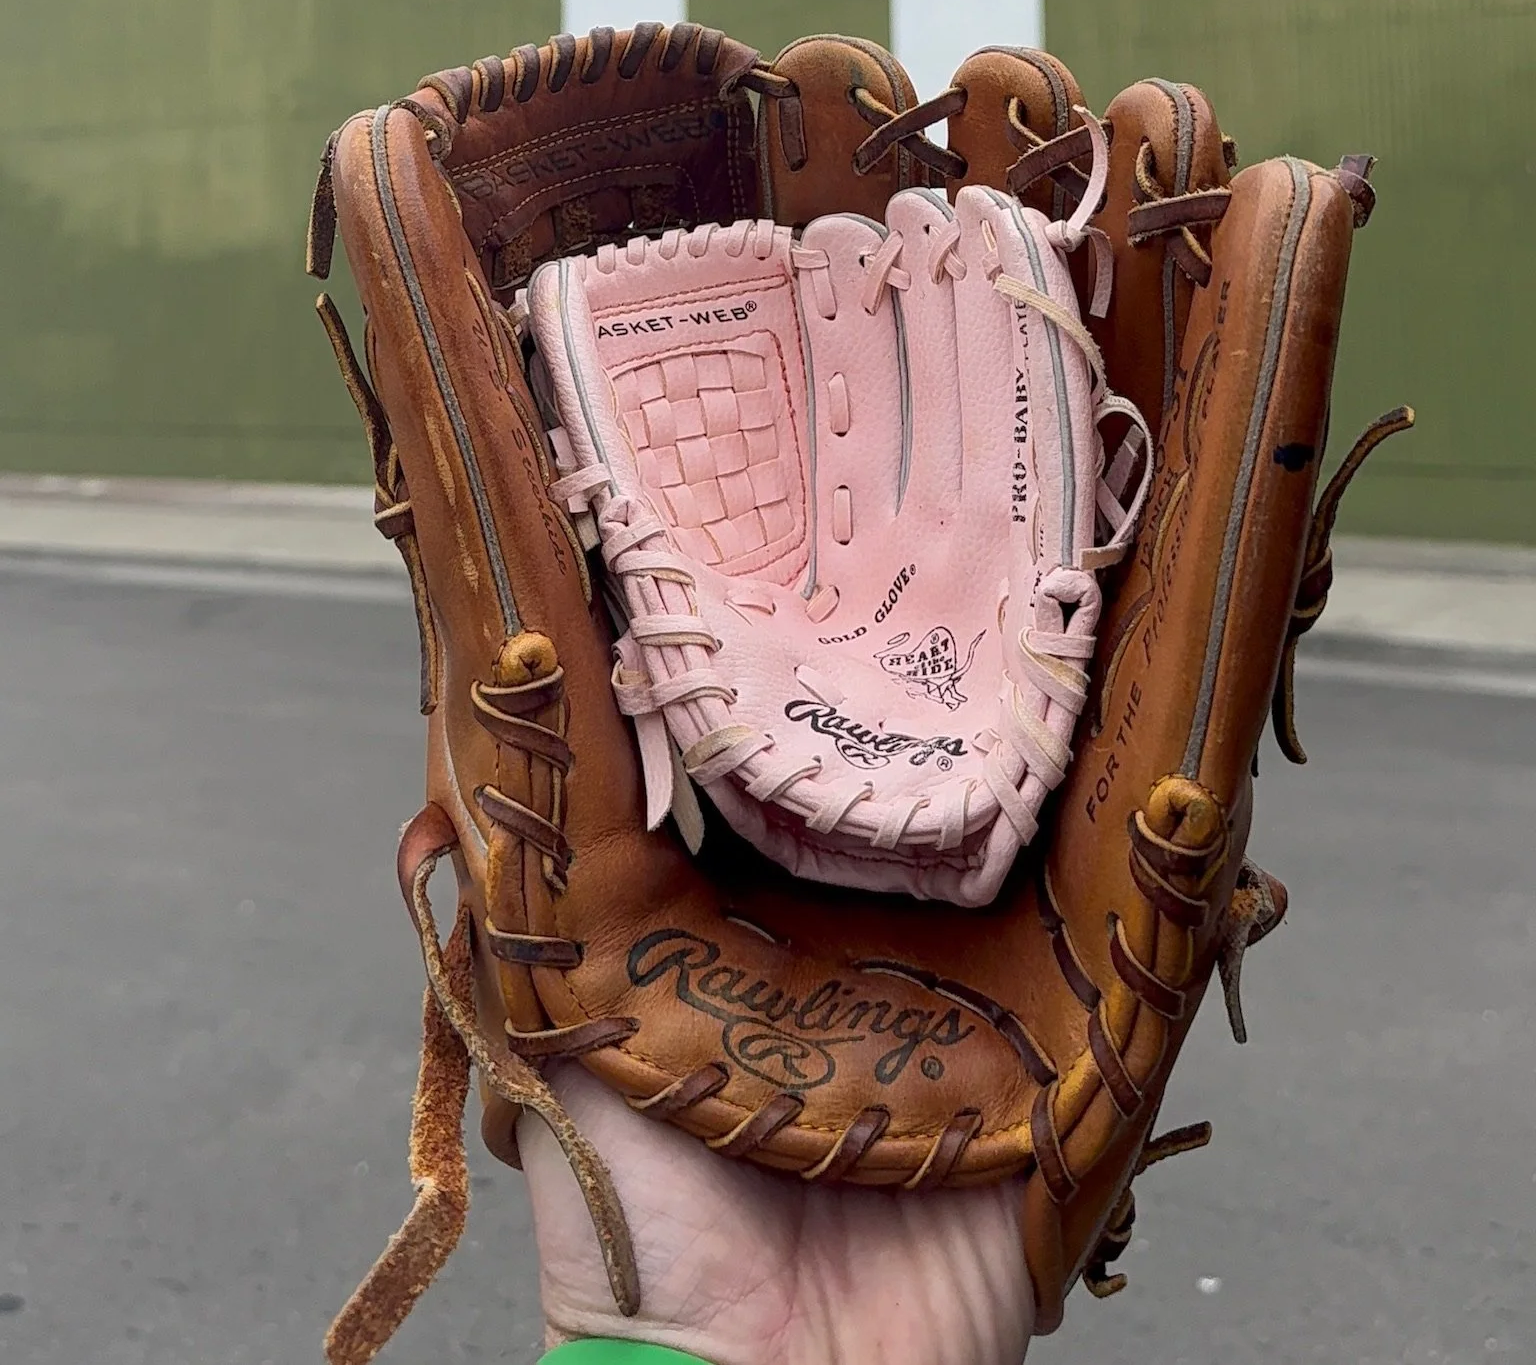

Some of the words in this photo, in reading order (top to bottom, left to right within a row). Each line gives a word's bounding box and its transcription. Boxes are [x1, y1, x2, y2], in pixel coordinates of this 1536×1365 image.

[817, 625, 869, 646] GOLD
[887, 637, 950, 667] HEART
[1084, 751, 1121, 824] FOR
[1115, 680, 1143, 748] THE
[626, 928, 977, 1084] Rawlings
